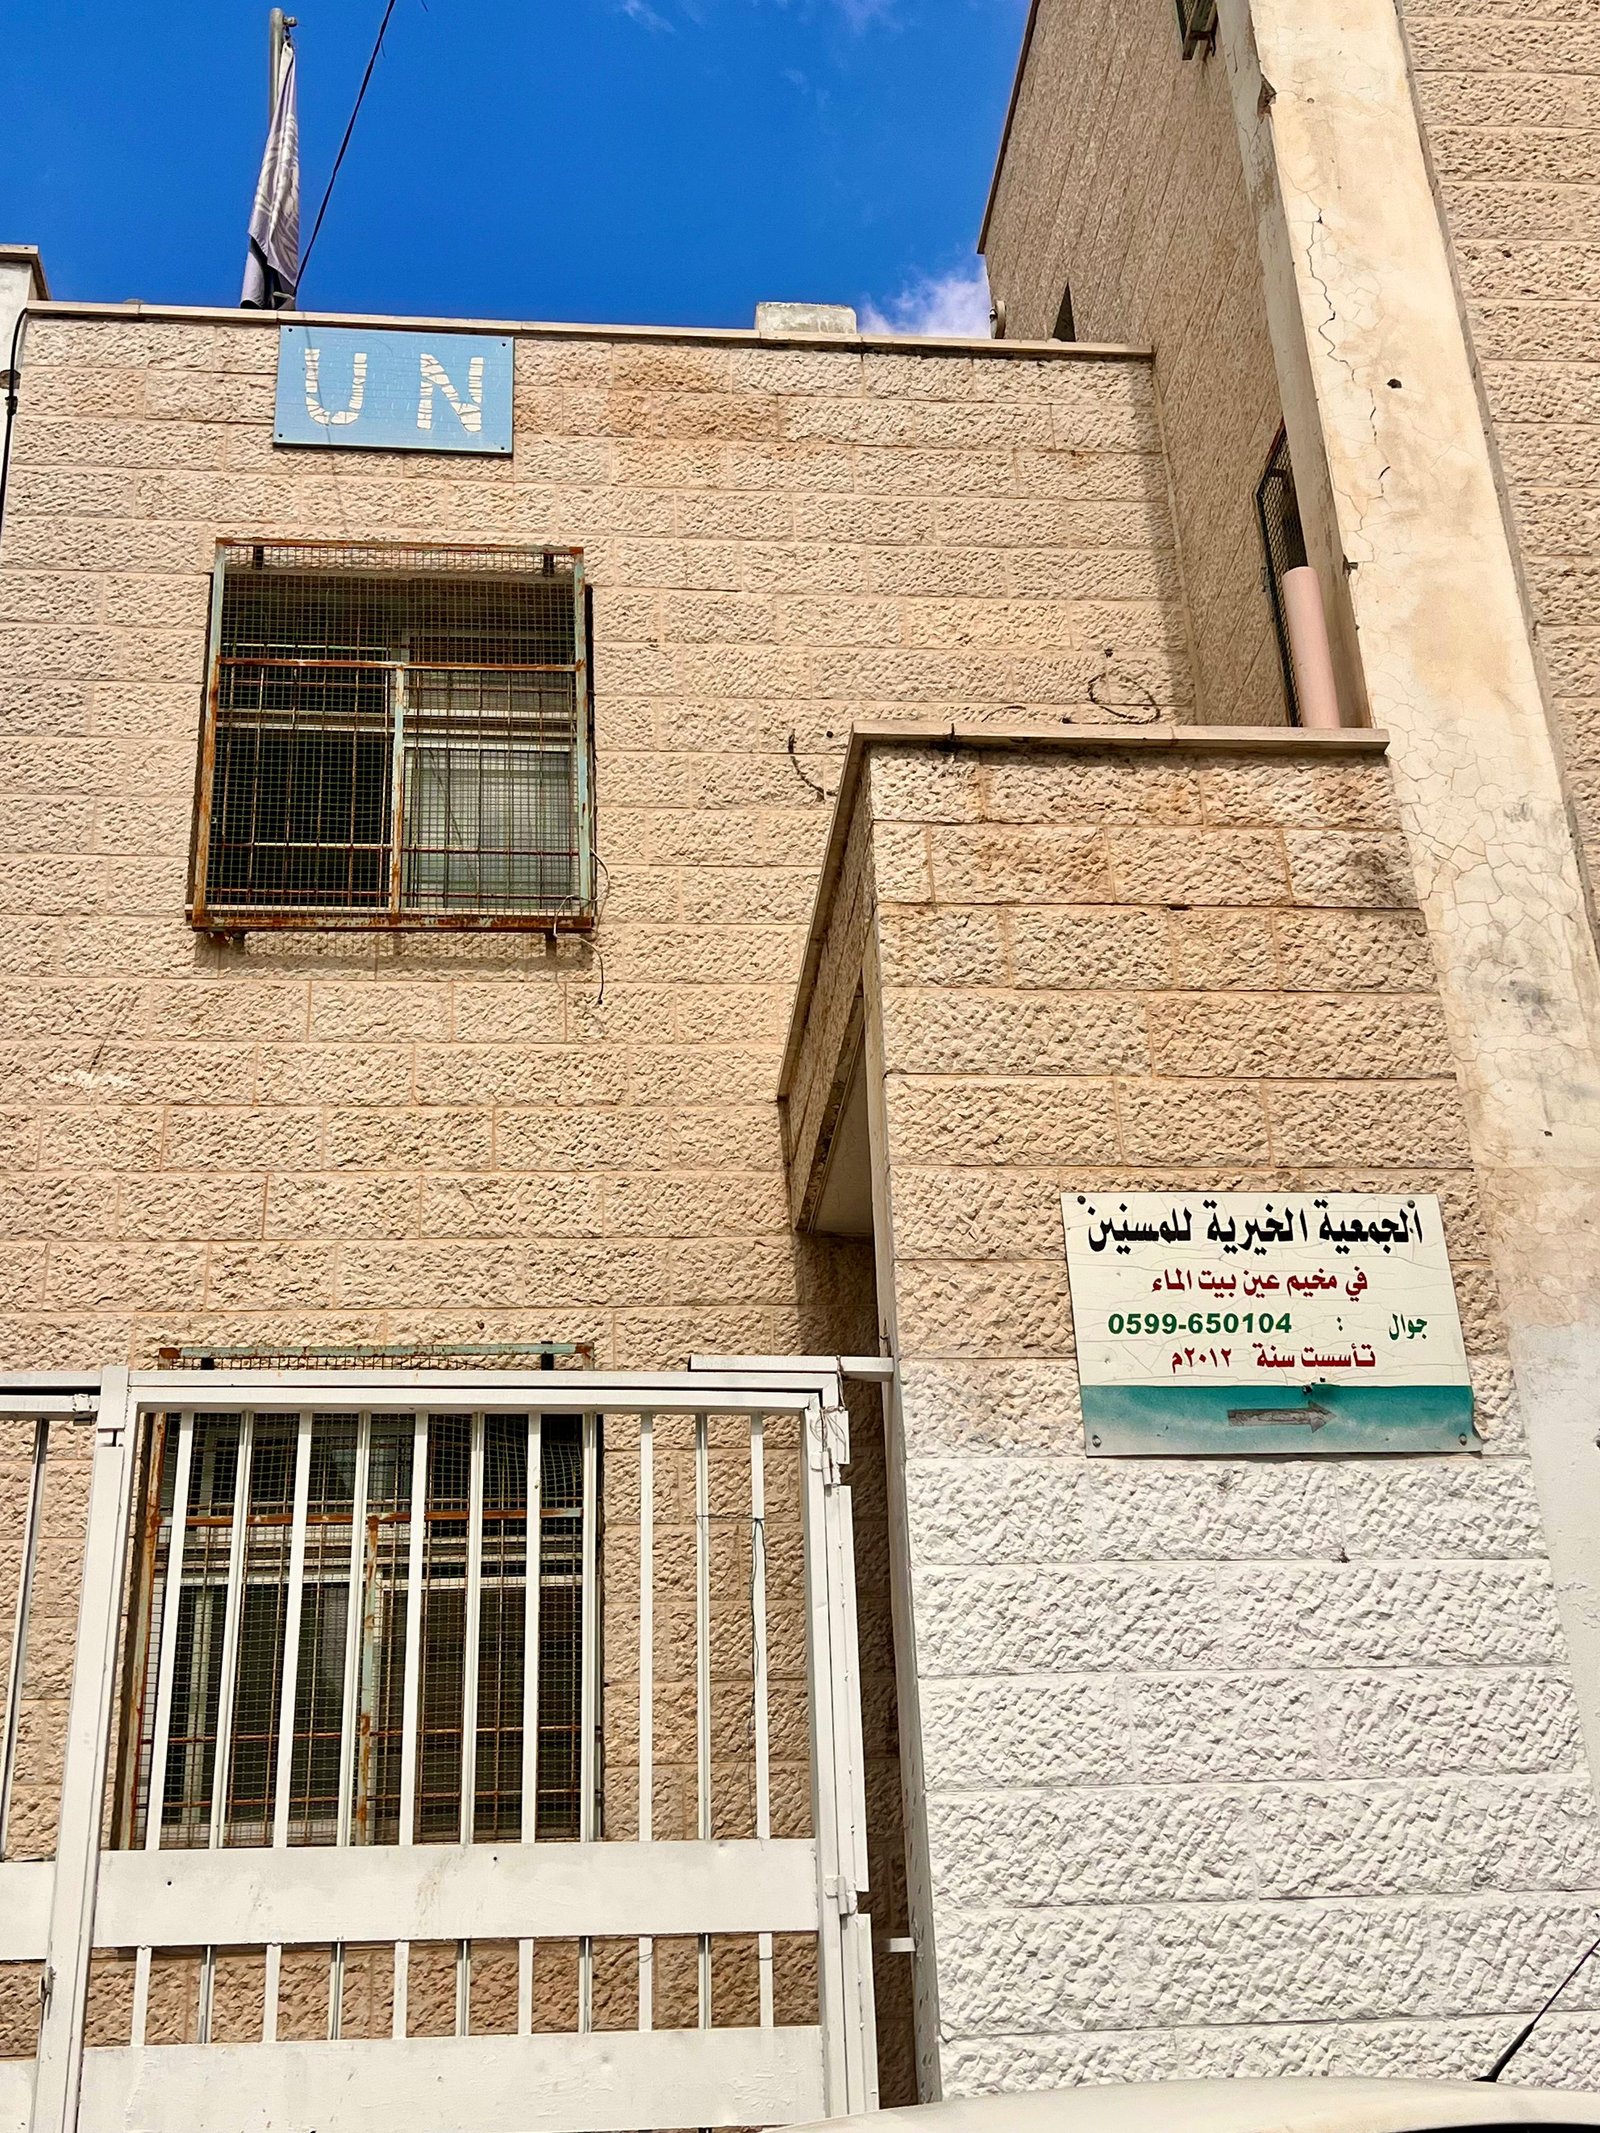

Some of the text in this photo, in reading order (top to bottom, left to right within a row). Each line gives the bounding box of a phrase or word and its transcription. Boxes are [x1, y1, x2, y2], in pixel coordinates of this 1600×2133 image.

[1088, 1199, 1423, 1256] الجمعية الخيرية للمسنين
[1151, 1265, 1368, 1302] في مخيم عين بيت الماء
[1107, 1312, 1293, 1335] 0599-650104
[1388, 1313, 1429, 1341] جوال
[1252, 1342, 1296, 1369] سنة
[1300, 1342, 1377, 1369] تأسست
